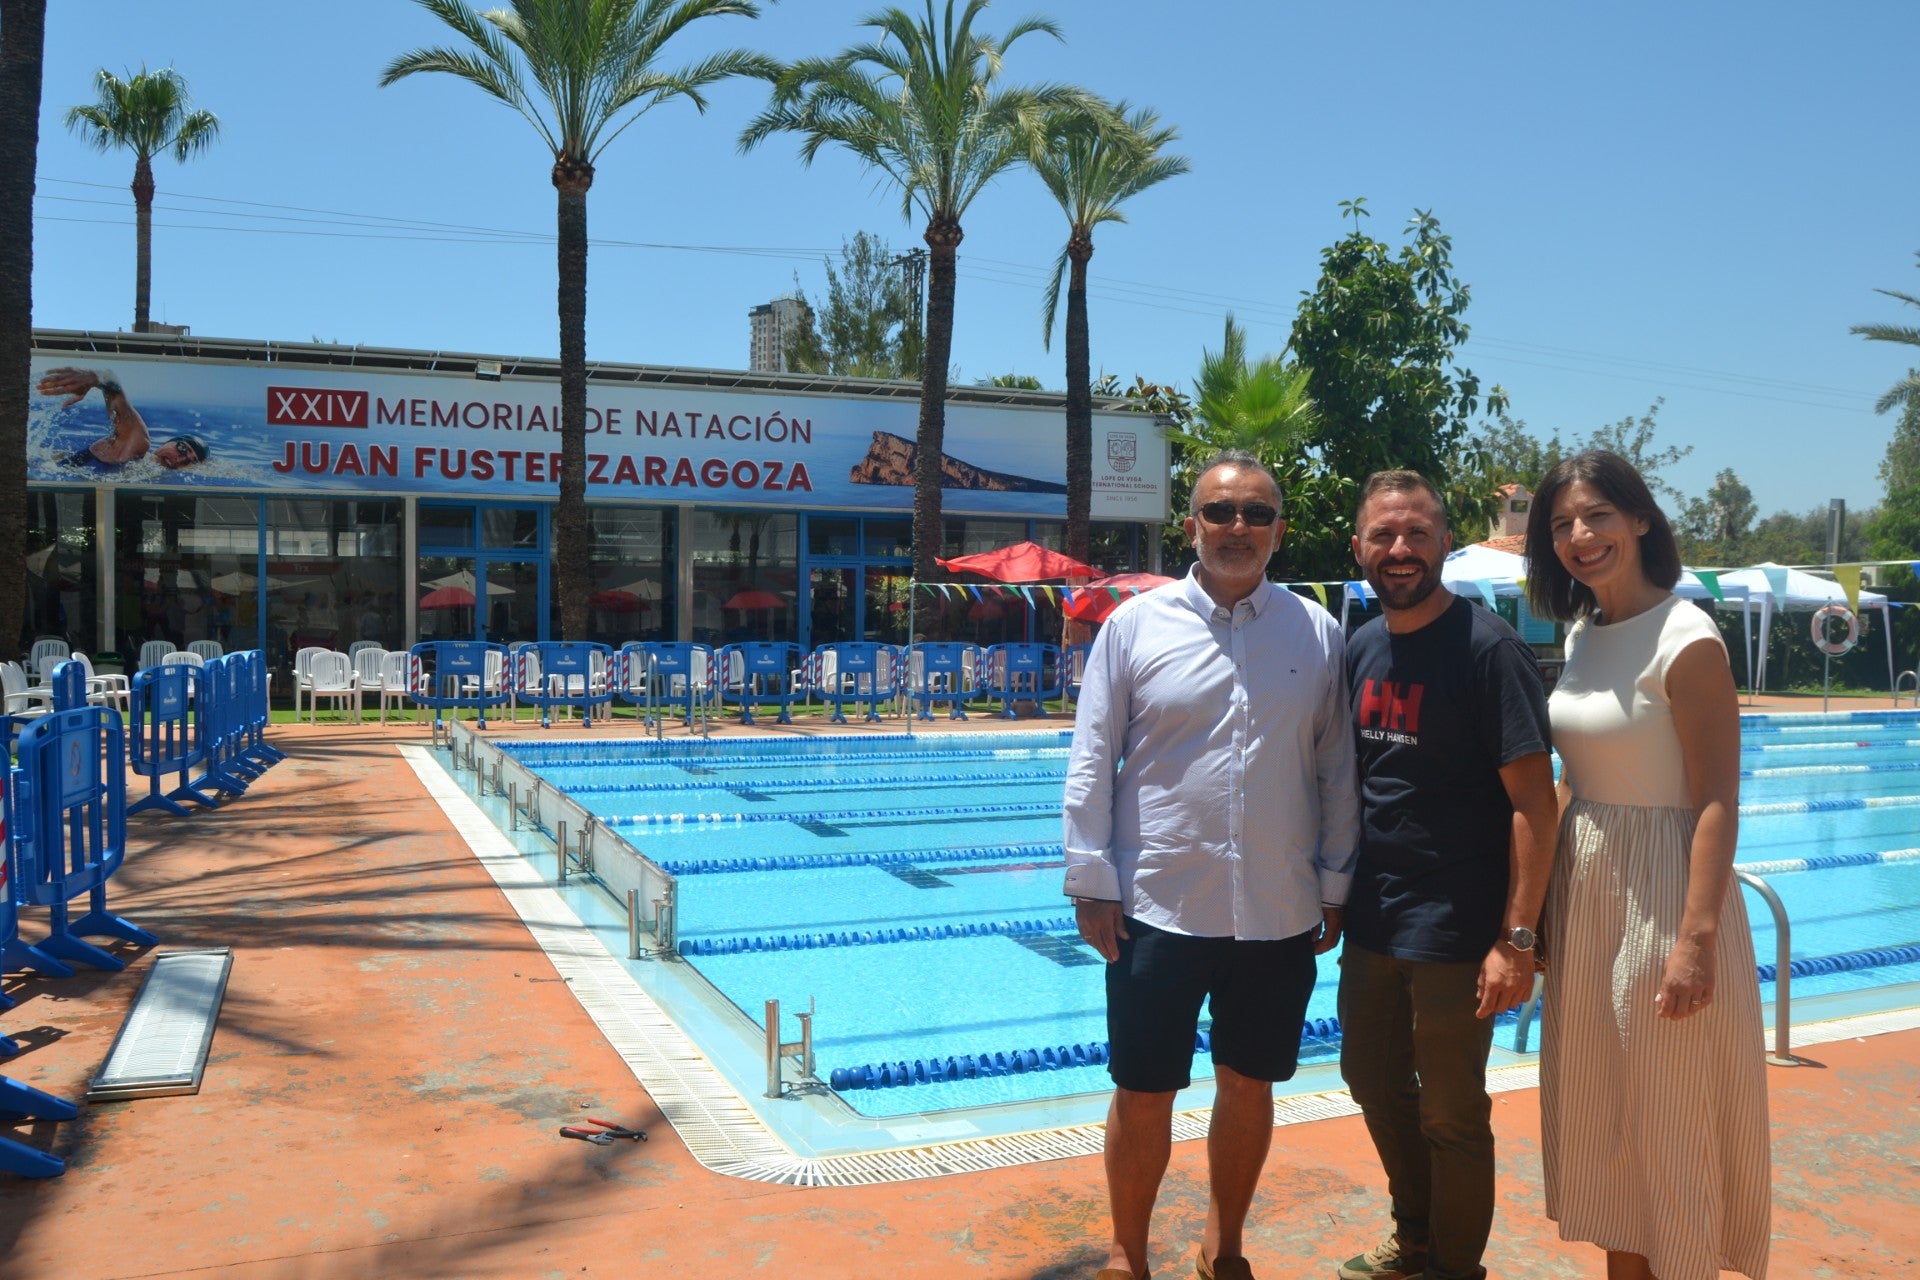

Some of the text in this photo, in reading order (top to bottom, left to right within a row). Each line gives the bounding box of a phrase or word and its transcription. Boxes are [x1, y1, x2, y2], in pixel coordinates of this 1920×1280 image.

[275, 391, 812, 444] XXIV MEMORIAL DE NATACIÓN
[272, 441, 398, 478] JUAN
[587, 454, 812, 492] ZARAGOZA
[1361, 729, 1418, 745] HELLY HANSEN
